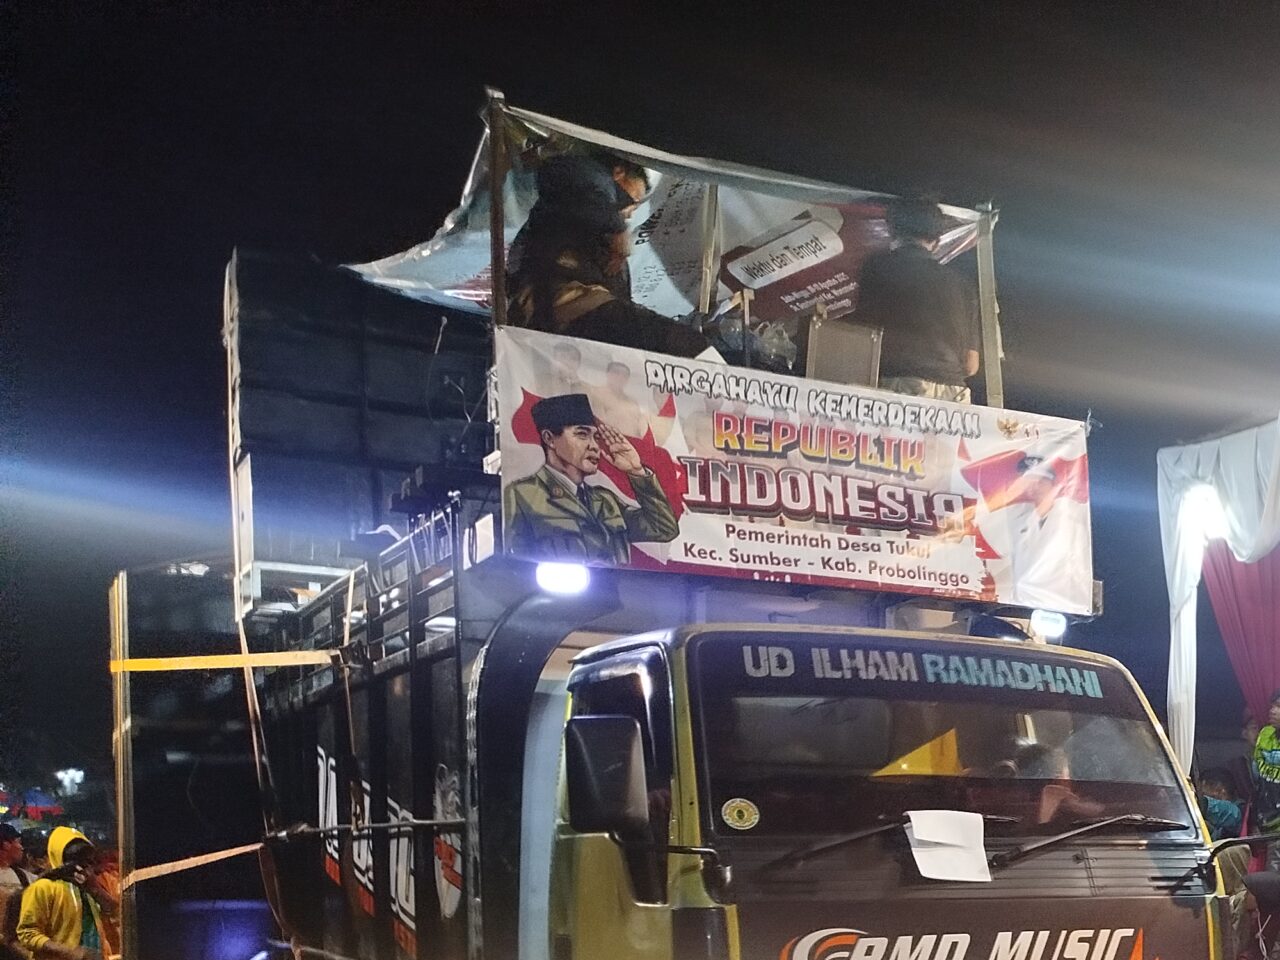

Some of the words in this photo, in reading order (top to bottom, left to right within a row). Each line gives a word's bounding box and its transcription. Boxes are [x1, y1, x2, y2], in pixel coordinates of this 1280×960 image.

[741, 258, 776, 281] Waktu
[769, 252, 794, 270] dan
[783, 234, 827, 259] Tempat
[645, 361, 799, 411] DIRGAHAYU
[807, 389, 982, 439] KEMERDEKAAN
[712, 410, 926, 477] REPUBLIK
[679, 456, 965, 530] INDONESIA
[725, 524, 831, 550] Pemerintah
[838, 537, 880, 553] Desa
[683, 542, 722, 562] Kec.
[729, 550, 801, 568] Sumber
[822, 557, 862, 574] Kab.
[869, 561, 969, 587] Probolinggo
[743, 646, 795, 677] UD
[811, 647, 919, 682] ILHAM
